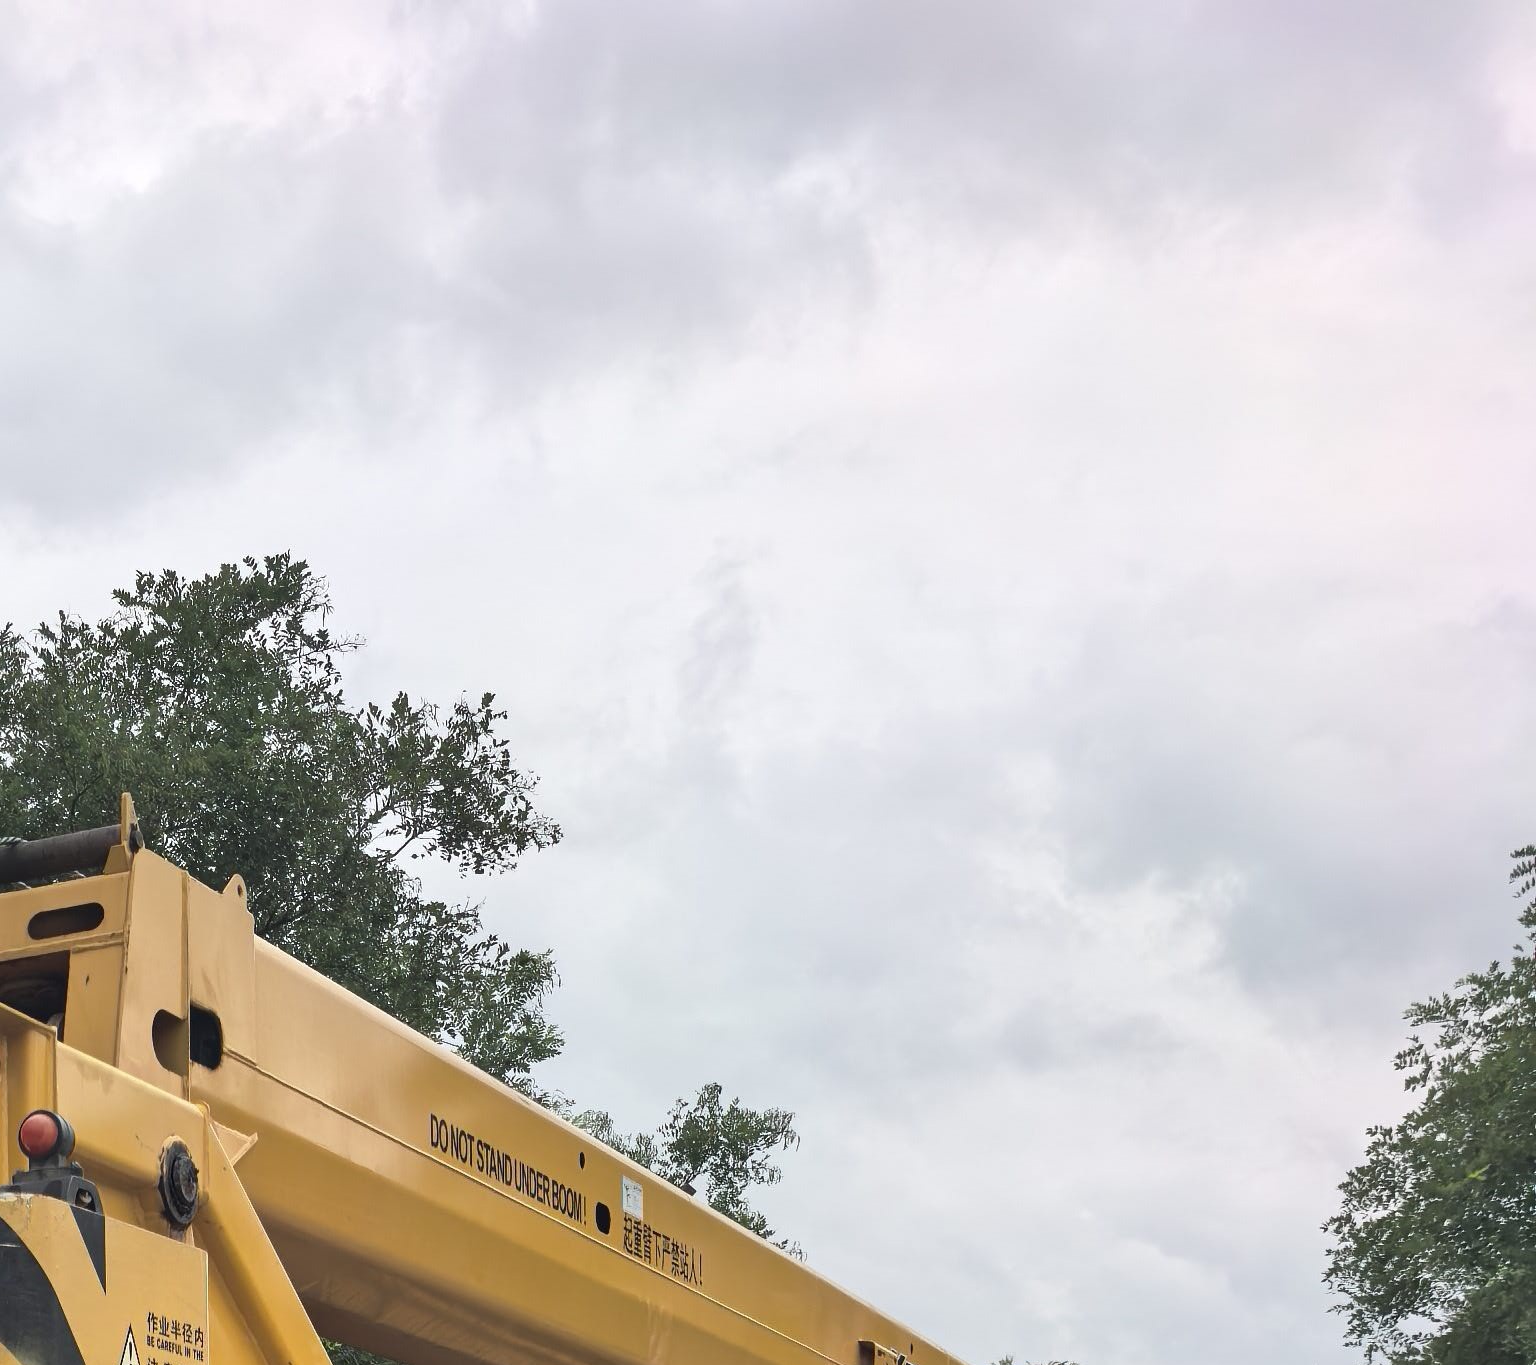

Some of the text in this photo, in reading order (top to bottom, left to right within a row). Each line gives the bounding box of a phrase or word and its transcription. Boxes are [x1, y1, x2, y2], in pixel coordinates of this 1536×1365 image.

[430, 1113, 449, 1154] DO
[450, 1124, 475, 1168] NOT
[476, 1139, 513, 1187] STAND
[514, 1158, 551, 1208] UNDER
[146, 1311, 204, 1348] 作业半径内
[146, 1335, 204, 1362] BE CAREFUL IN THE
